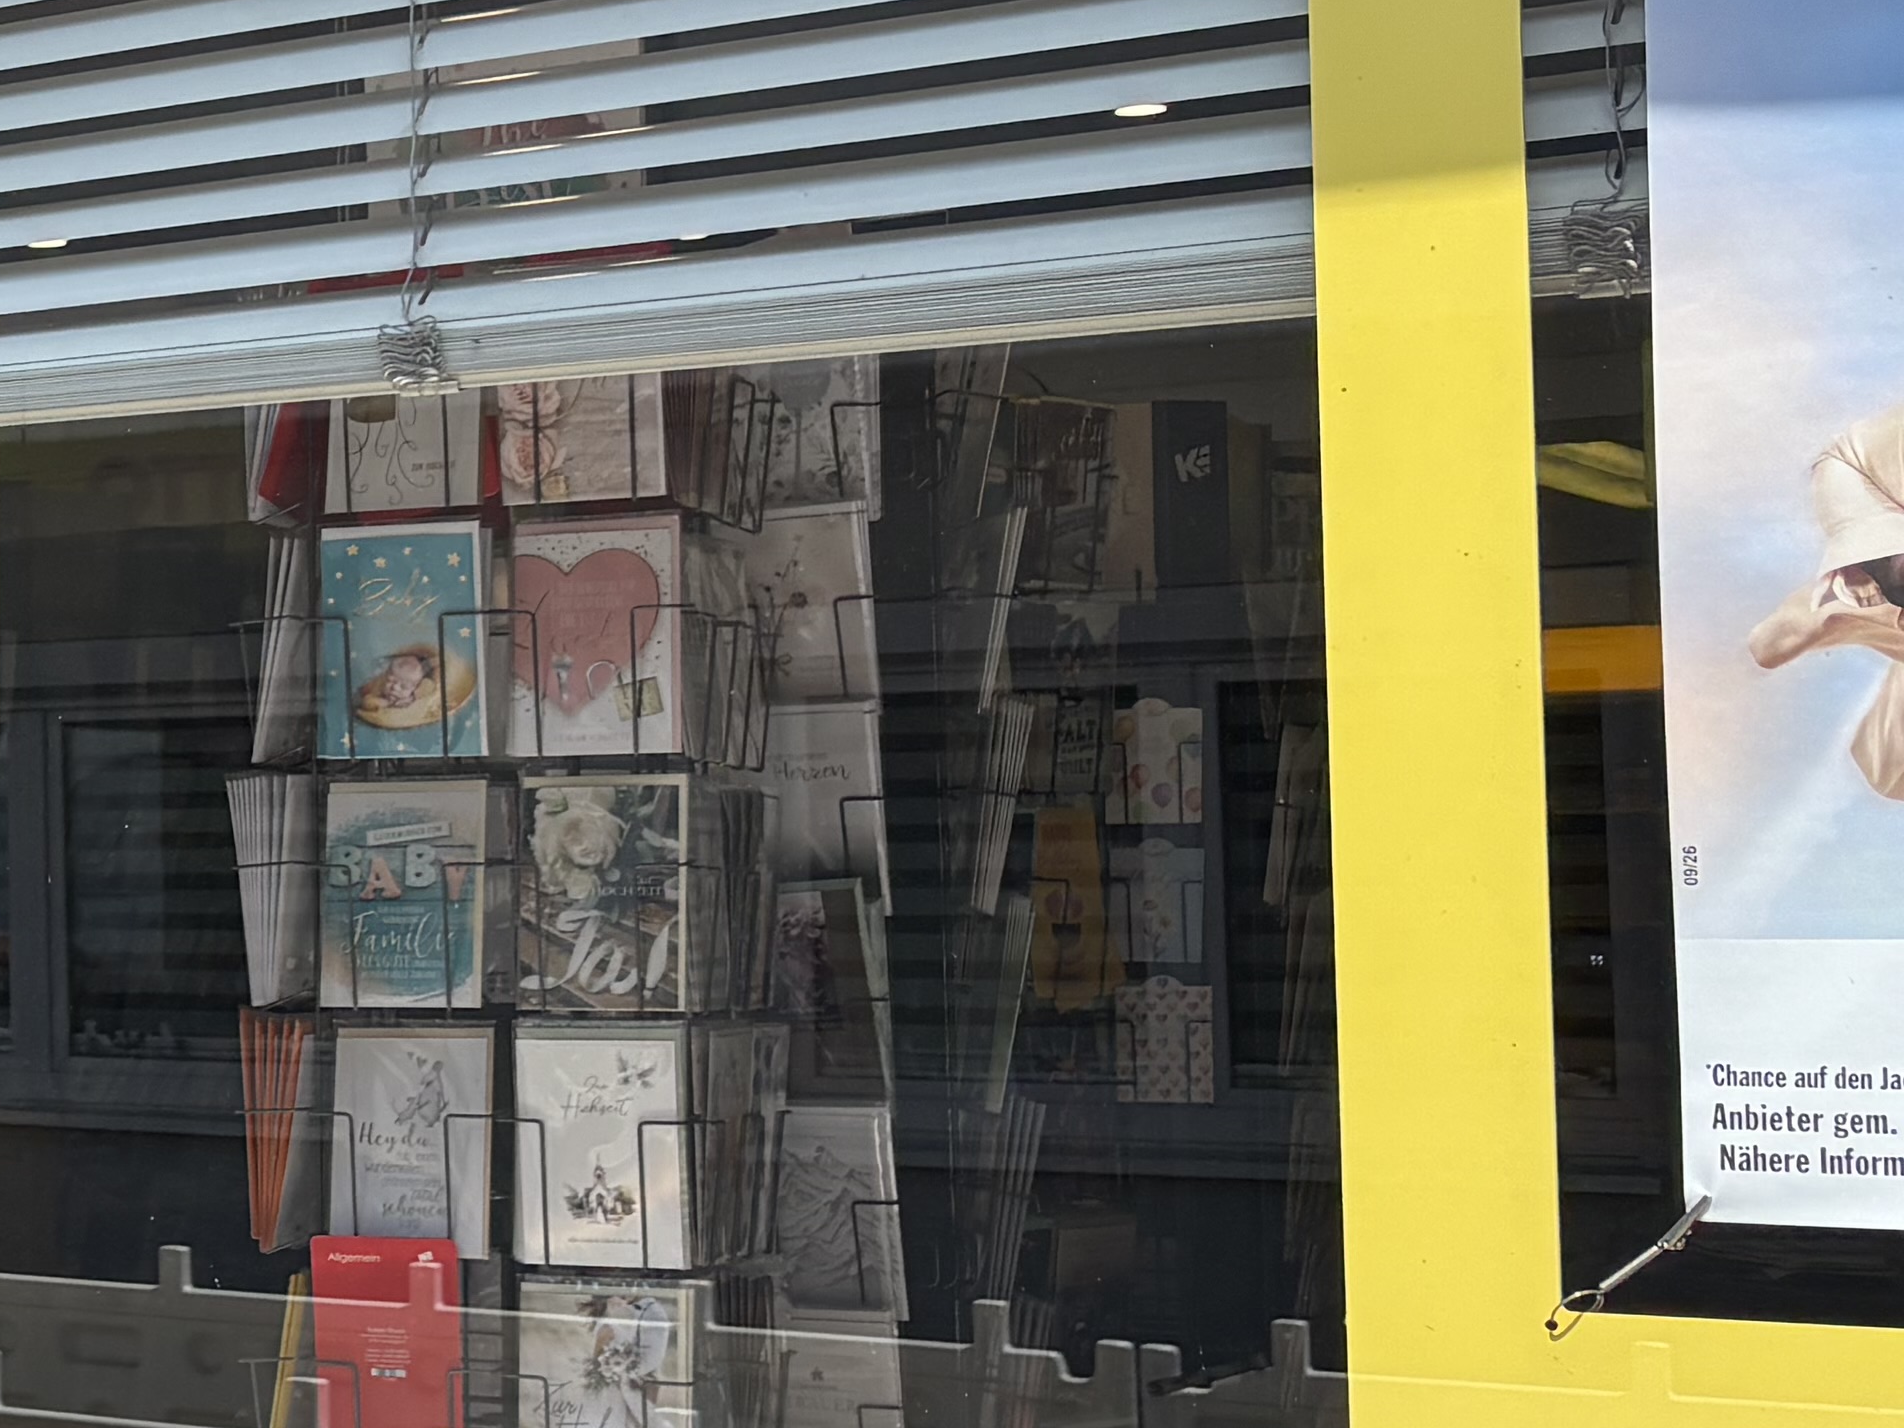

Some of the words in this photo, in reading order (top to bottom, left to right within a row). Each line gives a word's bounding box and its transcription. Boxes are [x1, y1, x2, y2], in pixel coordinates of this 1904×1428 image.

[1683, 845, 1699, 887] 09/26
[1794, 1066, 1828, 1090] auf
[1835, 1066, 1873, 1091] den
[1880, 1066, 1904, 1092] Ja
[1712, 1103, 1824, 1134] Anbieter
[1833, 1110, 1898, 1139] gem.
[1720, 1143, 1810, 1174] Nähere
[1819, 1146, 1904, 1177] Inform
